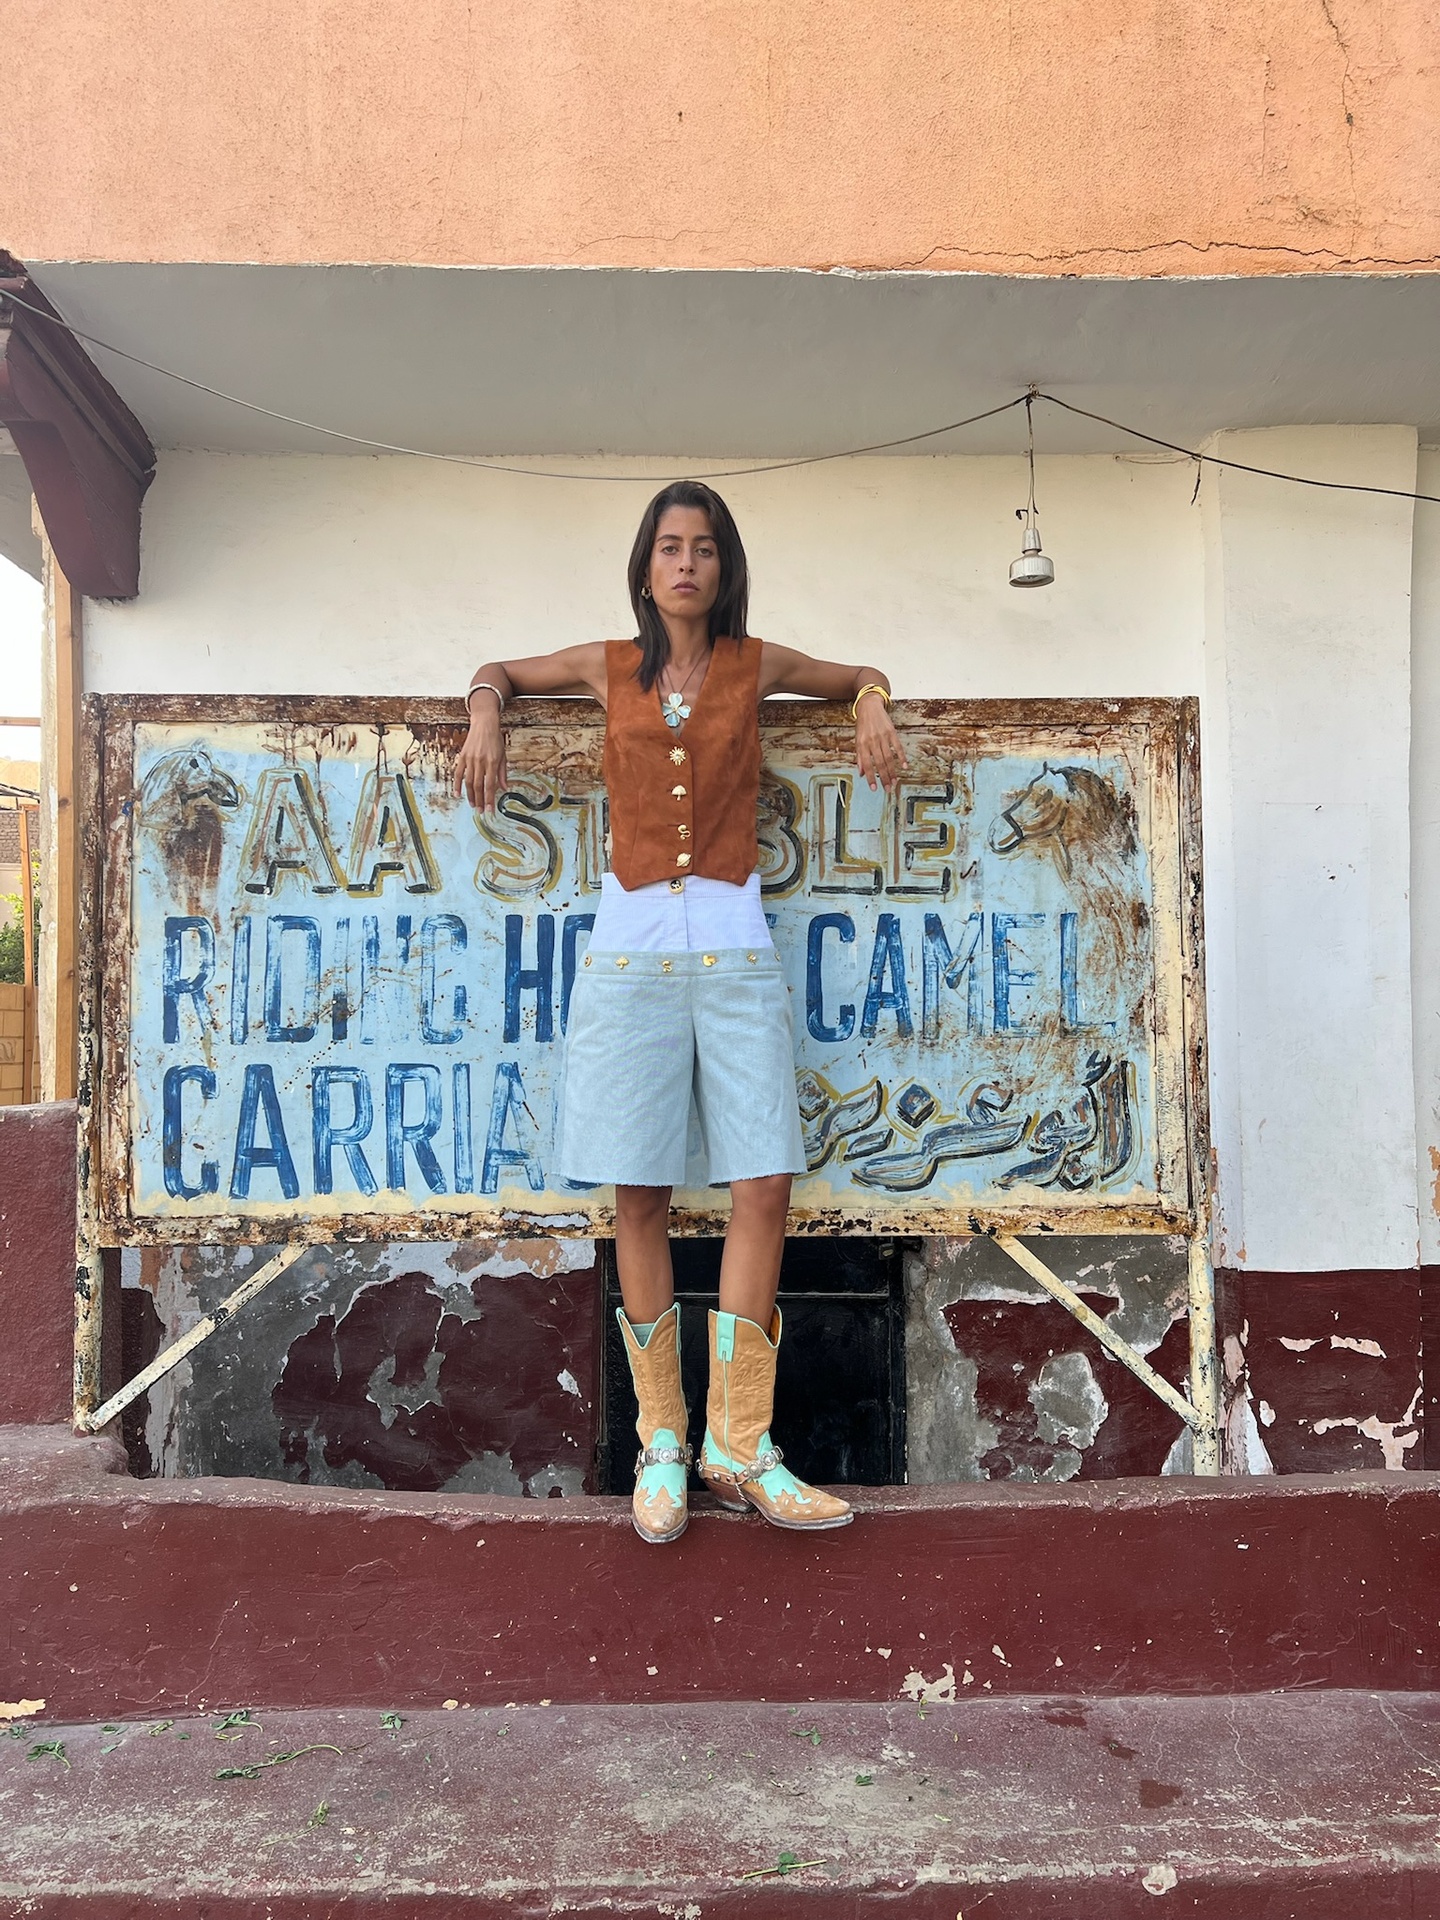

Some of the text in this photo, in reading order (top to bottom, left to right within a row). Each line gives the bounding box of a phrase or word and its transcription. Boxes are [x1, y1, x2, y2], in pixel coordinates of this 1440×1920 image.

[237, 766, 957, 902] AA STBLE
[806, 911, 1116, 1043] CAMEL
